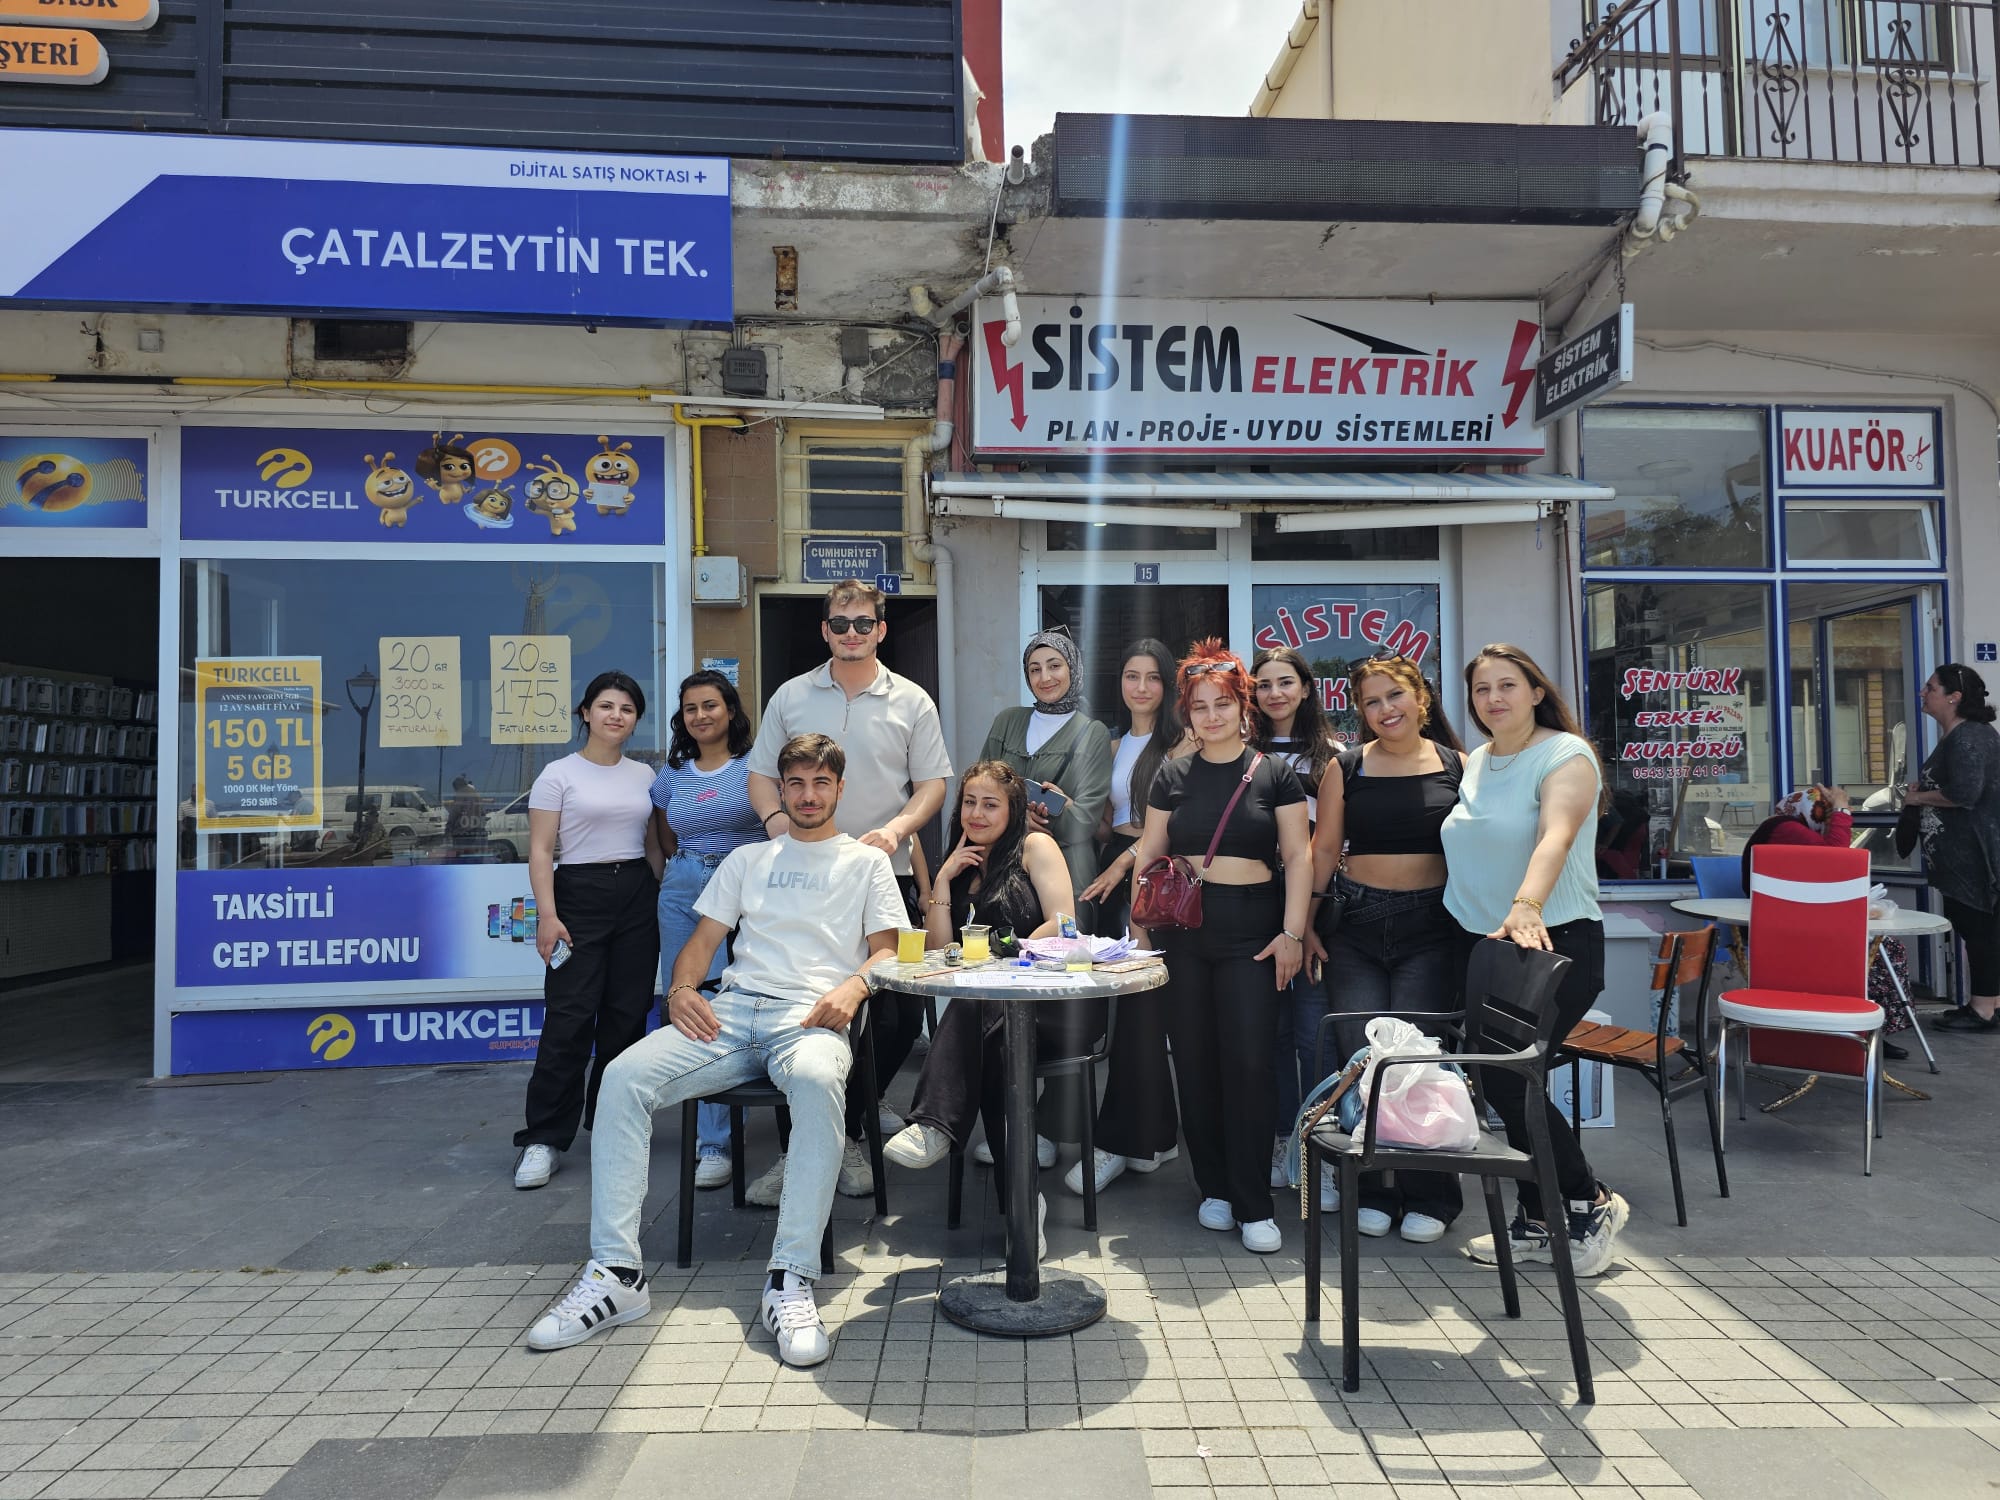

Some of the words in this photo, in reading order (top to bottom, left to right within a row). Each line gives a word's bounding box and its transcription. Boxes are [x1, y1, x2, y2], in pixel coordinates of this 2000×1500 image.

[510, 160, 567, 178] DİJİTAL
[572, 166, 616, 182] SATIŞ
[620, 167, 689, 183] NOKTASI
[281, 225, 600, 276] ÇATALZEYTİN
[615, 238, 708, 278] TEK.
[1031, 305, 1243, 394] SİSTEM
[1251, 348, 1479, 398] ELEKTRİK
[1553, 329, 1602, 375] SİSTEM
[1545, 352, 1610, 406] ELEKTRİK
[1047, 420, 1120, 442] PLAN
[1139, 413, 1228, 442] PROJE
[1246, 419, 1323, 442] UYDU
[1335, 412, 1493, 443] SİSTEMLERİ
[1783, 419, 1907, 472] KUAFÖR
[214, 489, 359, 510] TURKCELL
[811, 546, 878, 558] CUMHURİYET
[821, 559, 869, 569] MEYDANI
[882, 578, 894, 591] 14
[1140, 567, 1153, 580] 15
[1255, 603, 1432, 666] SİSTEM
[388, 641, 430, 673] 20
[434, 663, 448, 672] GB
[501, 641, 540, 672] 20
[539, 661, 557, 674] GB
[1983, 653, 1990, 661] A
[213, 666, 301, 683] TURKCELL
[391, 676, 428, 690] 3000
[432, 682, 445, 690] DK
[1621, 666, 1742, 701] ŞENTÜRK
[219, 704, 229, 712] 12
[229, 704, 243, 712] AY
[243, 702, 271, 712] SABİT
[273, 702, 301, 712] FİYAT
[385, 694, 432, 719] 330
[495, 680, 559, 717] 175
[1635, 710, 1723, 728] ERKEK
[207, 718, 267, 749] 150
[275, 717, 311, 747] TL
[1622, 736, 1743, 760] KUAFÖRÜ
[227, 755, 244, 781] 5
[252, 754, 293, 781] GB
[1633, 767, 1664, 779] 0543
[1667, 766, 1690, 779] 337
[1693, 766, 1708, 778] 41
[1712, 765, 1727, 777] 81
[223, 784, 245, 794] 1000
[246, 784, 259, 793] DK
[260, 784, 275, 793] Her
[276, 782, 299, 793] Yöne
[241, 798, 258, 807] 250
[259, 797, 278, 806] SMS
[212, 884, 334, 921] TAKSİTLİ
[212, 941, 270, 969] CEP
[276, 936, 420, 968] TELEFONU
[367, 1007, 546, 1043] TURKCEL
